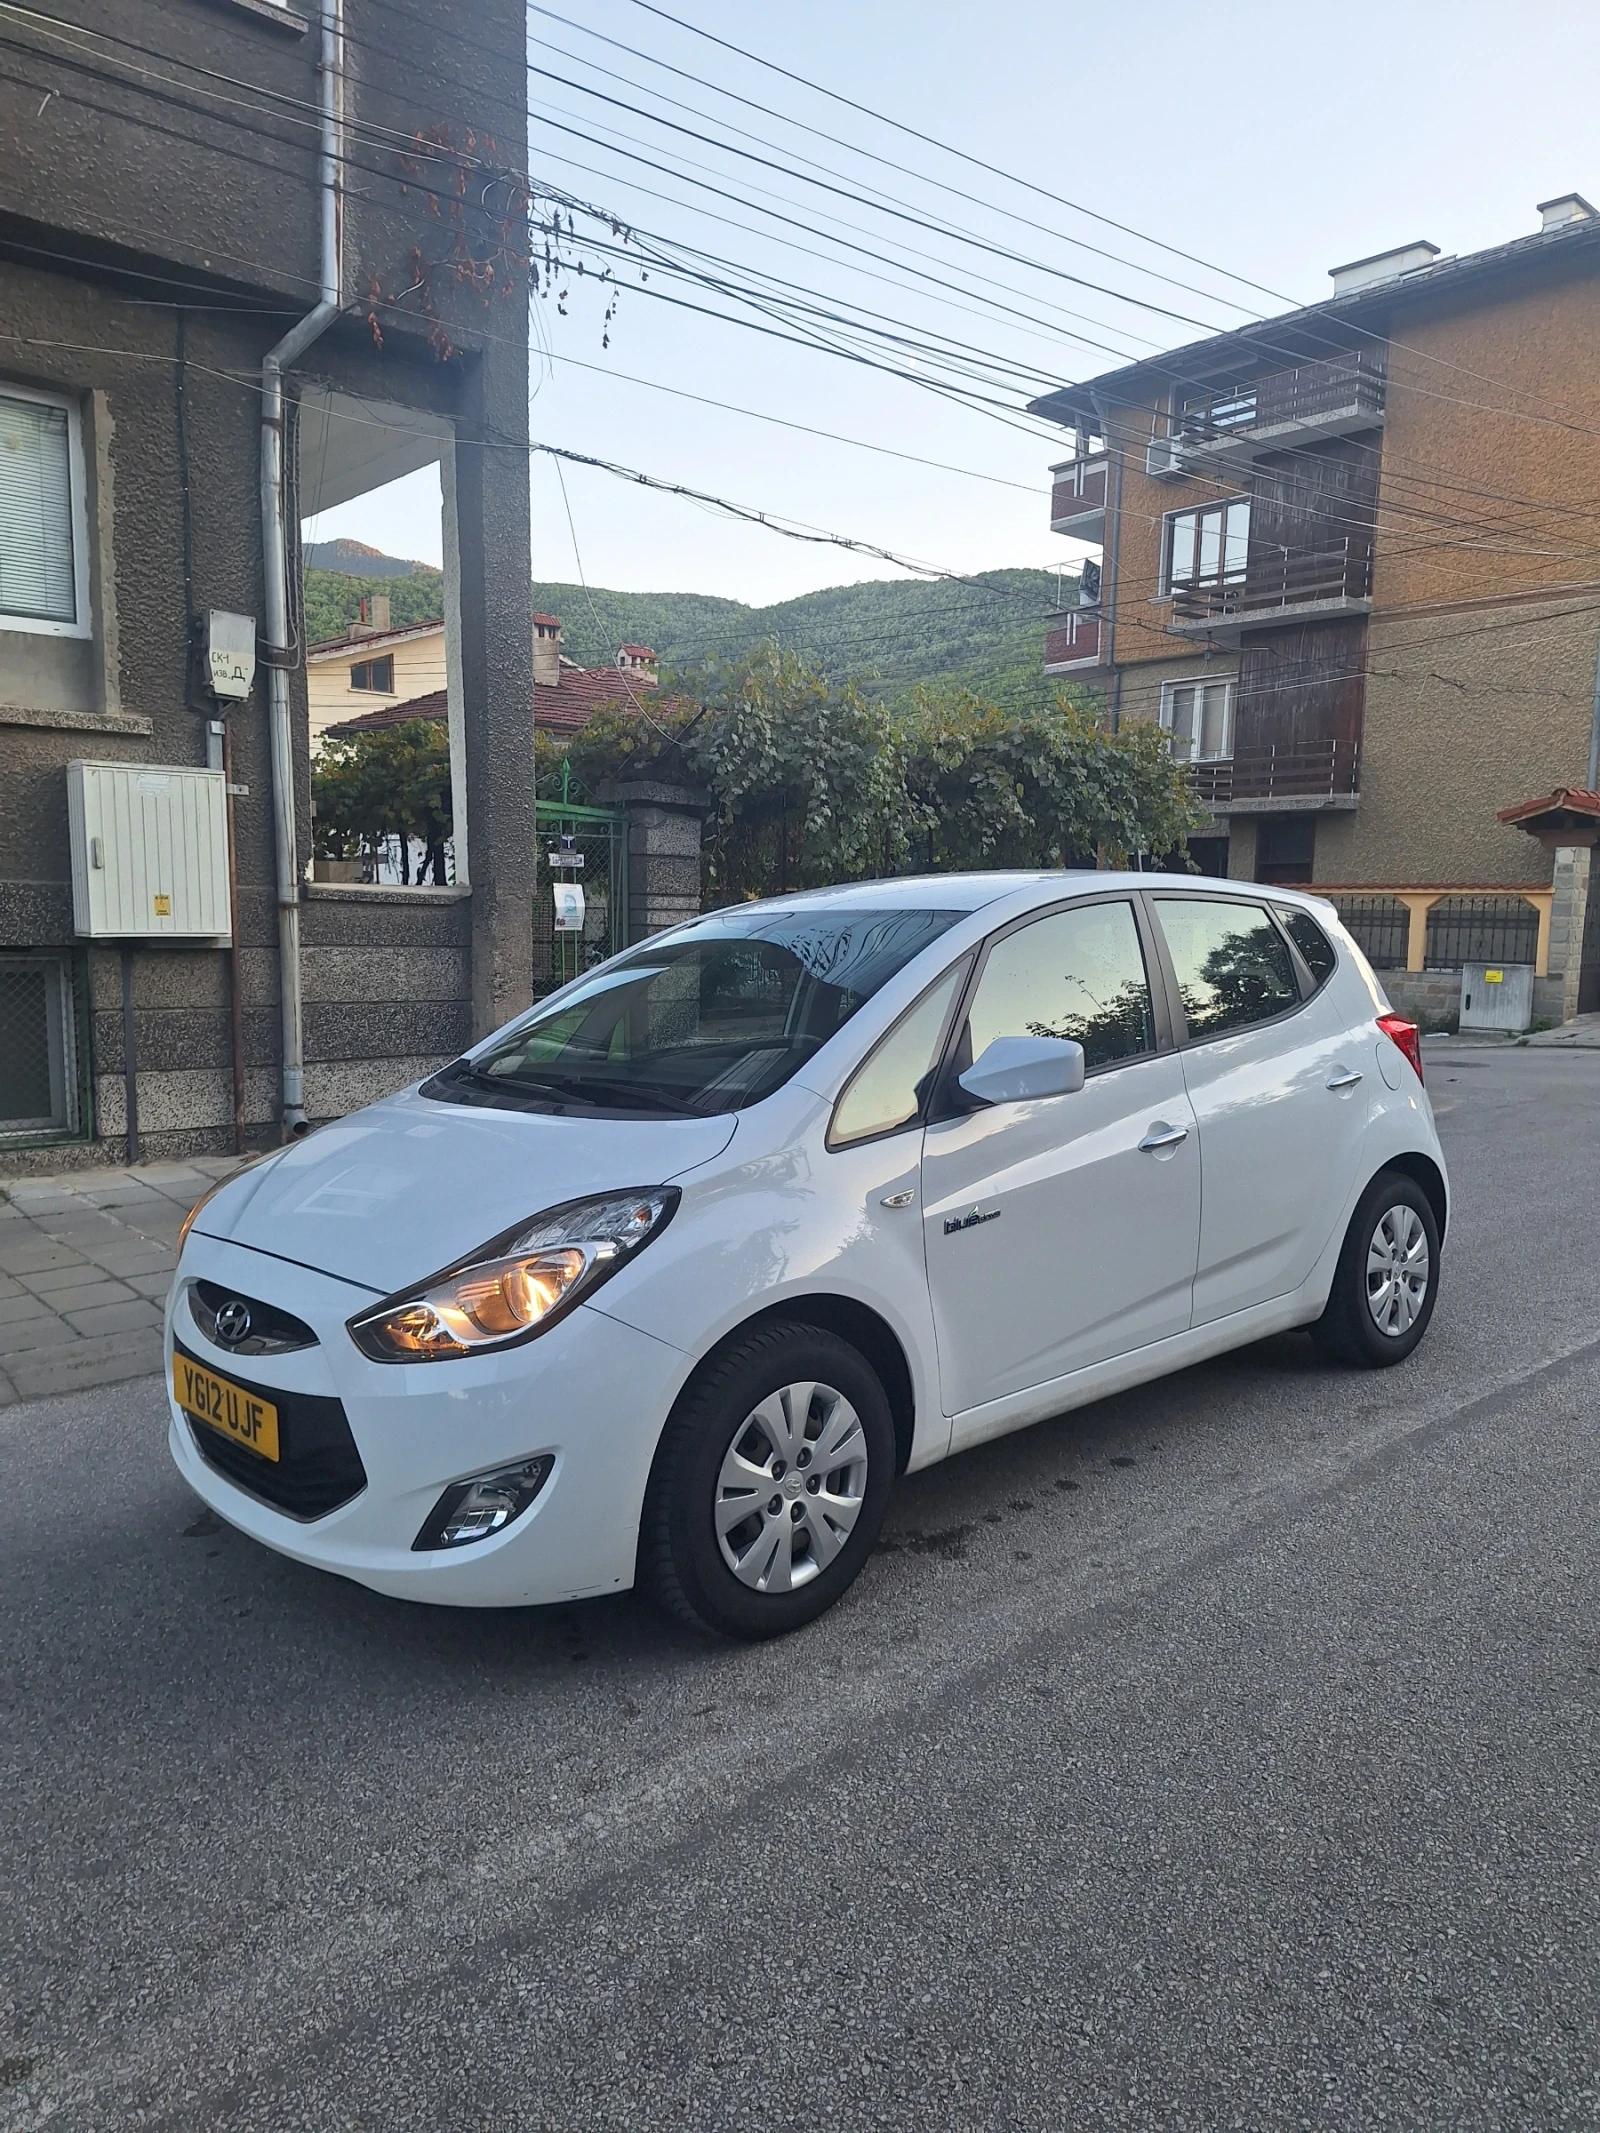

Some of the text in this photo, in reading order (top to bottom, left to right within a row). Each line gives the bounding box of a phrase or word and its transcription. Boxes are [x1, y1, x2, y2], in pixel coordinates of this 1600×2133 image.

[943, 1214, 979, 1236] blue
[183, 1363, 264, 1443] YG12 UJF
